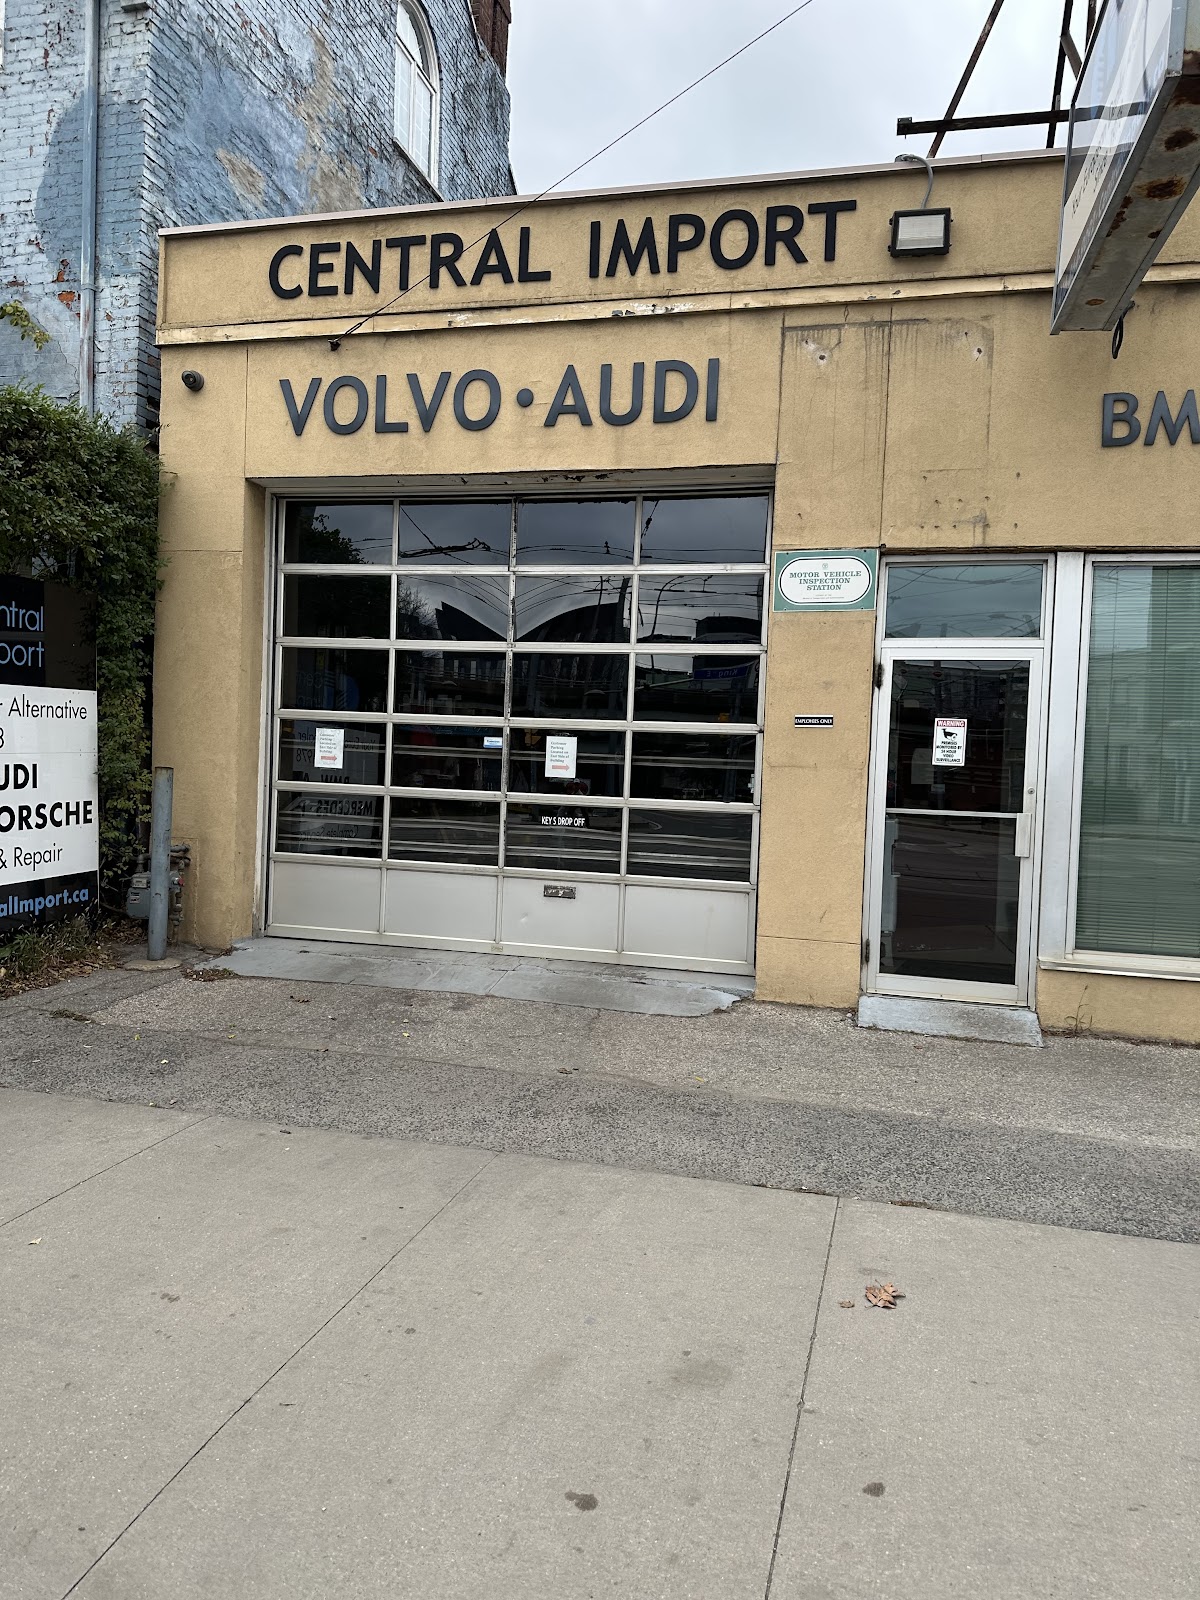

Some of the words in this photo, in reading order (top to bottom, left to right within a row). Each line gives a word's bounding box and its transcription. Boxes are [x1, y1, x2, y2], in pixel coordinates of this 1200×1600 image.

[268, 226, 552, 299] CENTRAL
[588, 199, 858, 279] IMPORT
[279, 369, 501, 436] VOLVO
[544, 357, 720, 428] AUDI
[1101, 389, 1200, 448] BM
[8, 693, 88, 720] Alternative
[557, 816, 573, 826] DROP
[573, 818, 585, 826] OFF
[14, 843, 63, 871] Repair
